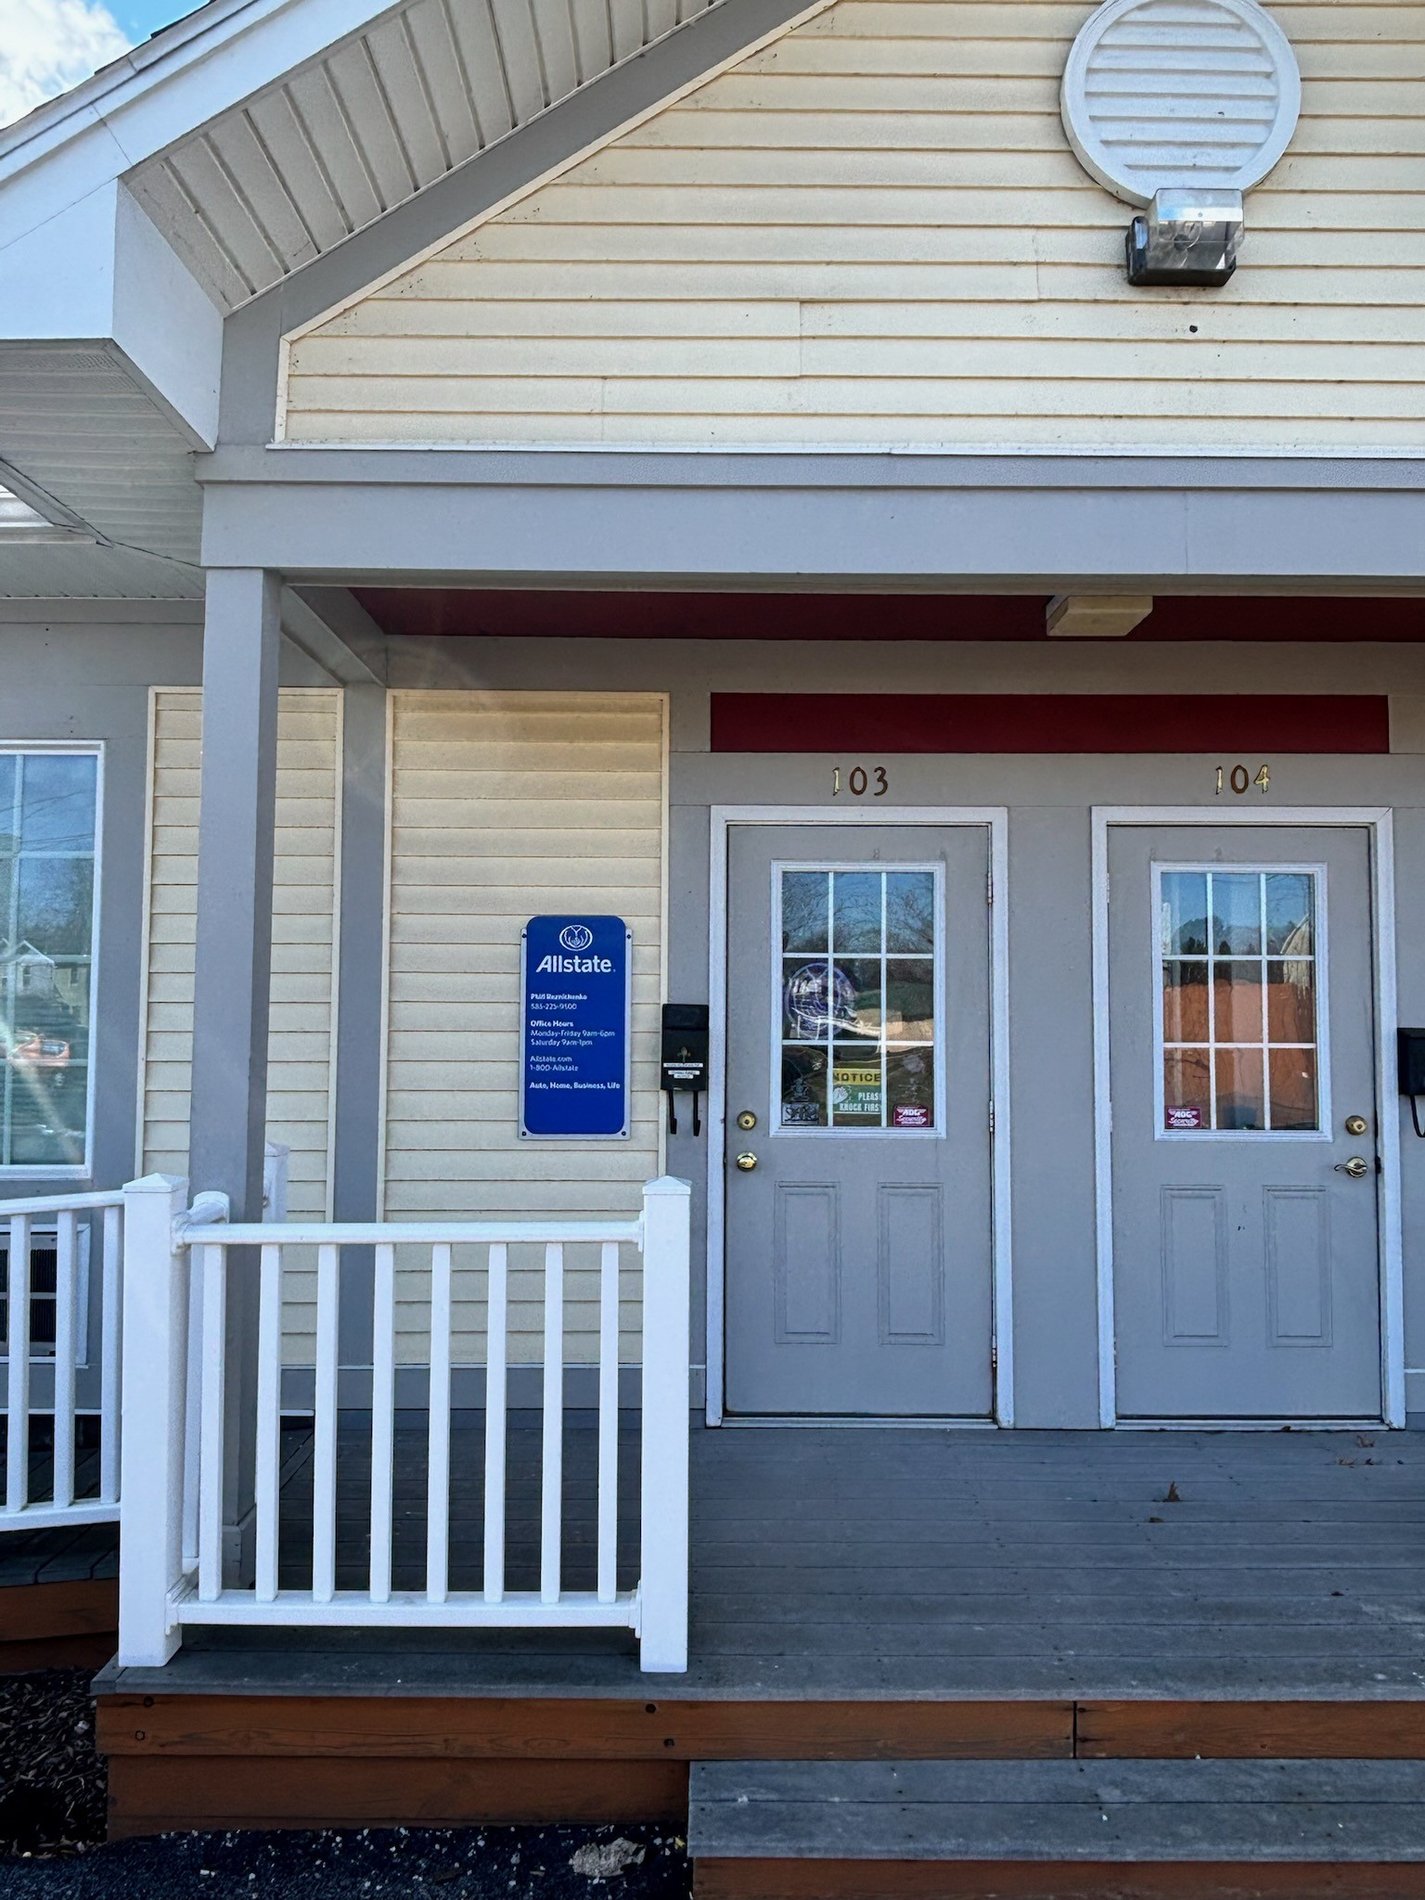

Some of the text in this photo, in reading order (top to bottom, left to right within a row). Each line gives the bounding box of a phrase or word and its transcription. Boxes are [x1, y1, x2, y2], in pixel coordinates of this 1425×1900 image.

[832, 766, 889, 797] 103
[1215, 764, 1272, 796] 104
[536, 955, 612, 973] Allstate
[530, 1030, 581, 1038] Monday-Friday
[530, 1039, 560, 1047] Saturday
[529, 1064, 579, 1072] 1-800-Allstate
[529, 1082, 549, 1090] Auto,
[549, 1082, 572, 1090] Home,
[573, 1082, 606, 1090] Business,
[839, 1103, 862, 1111] KNOCK
